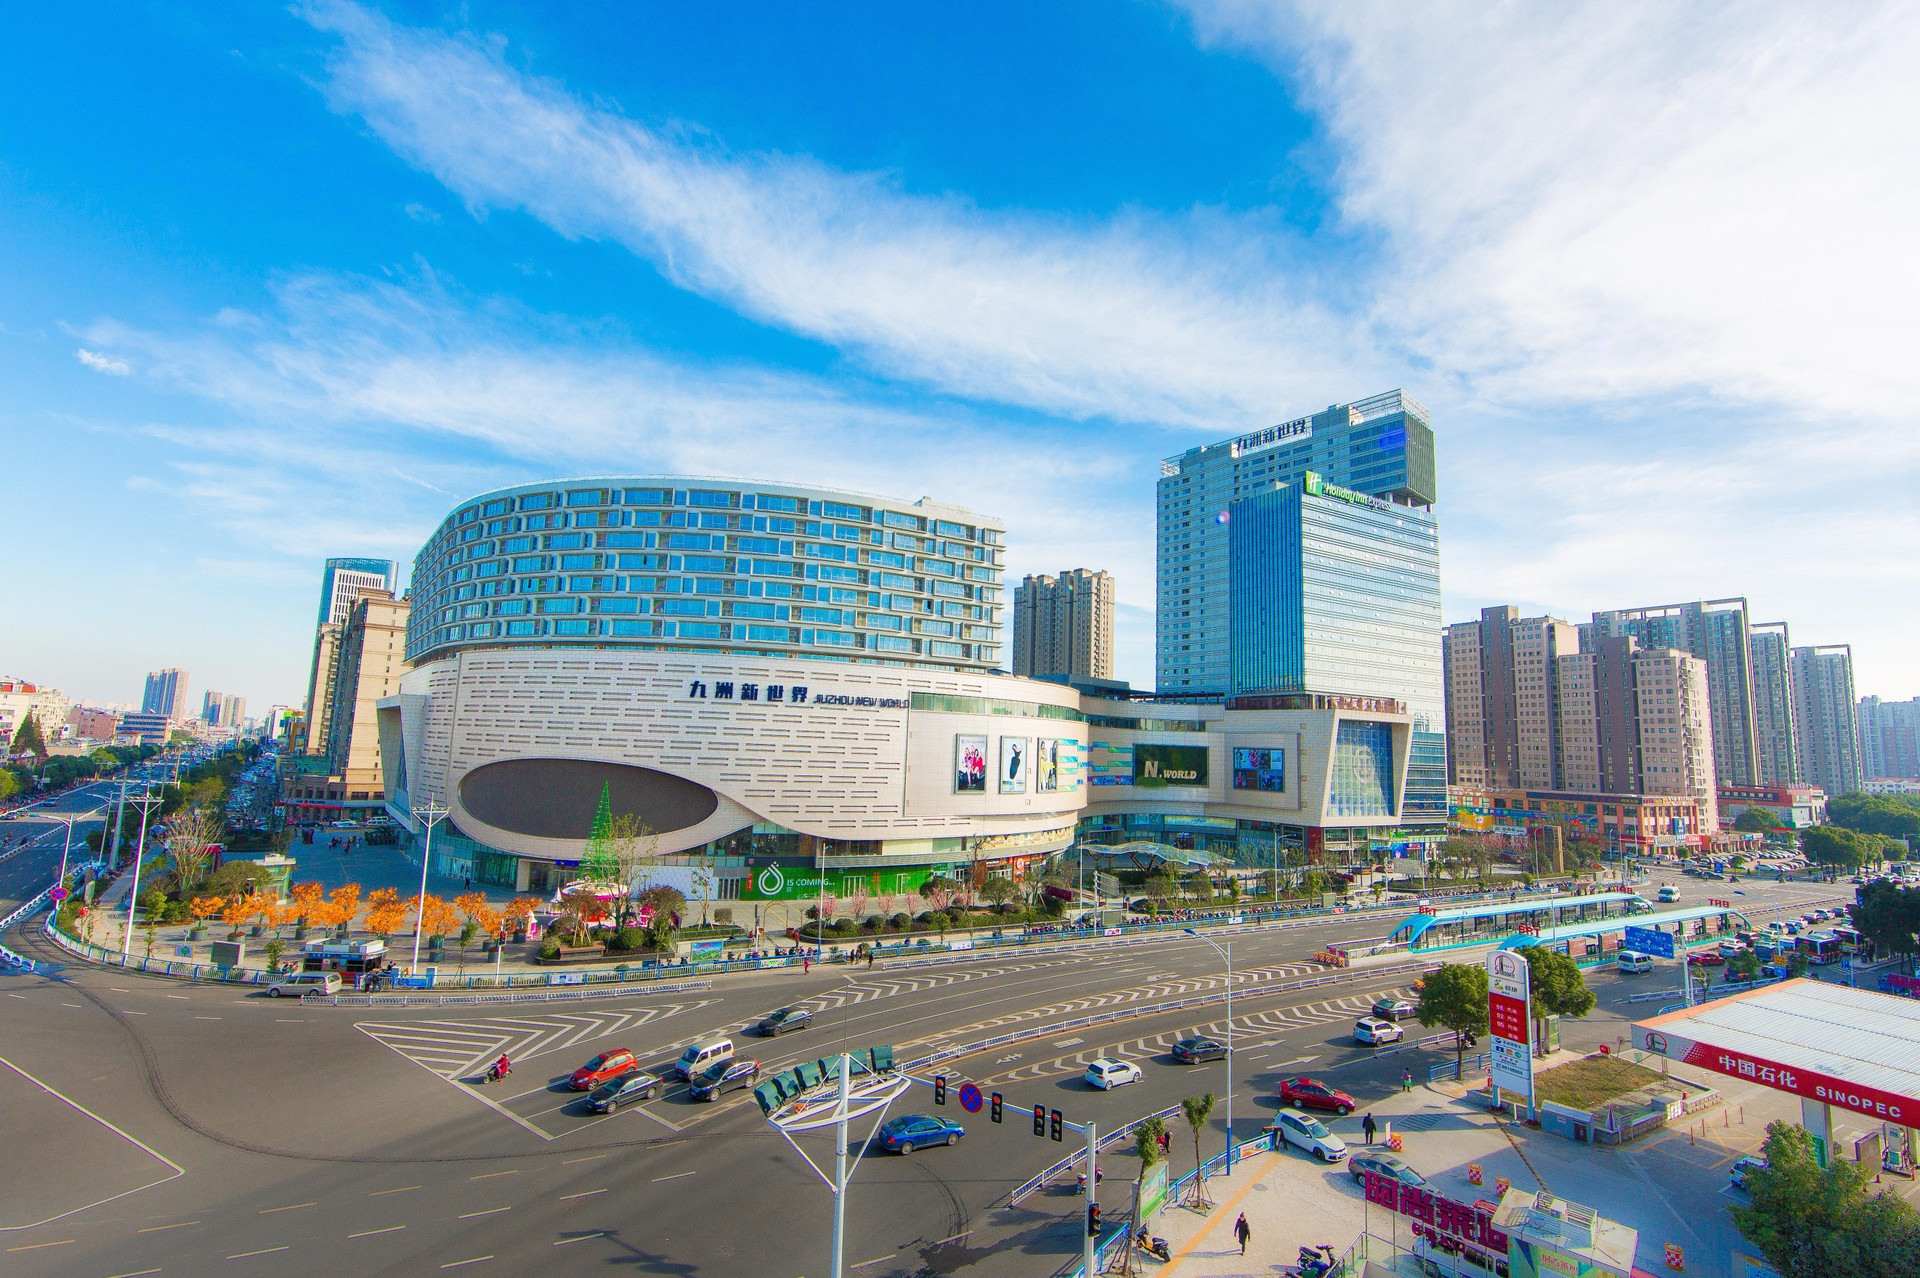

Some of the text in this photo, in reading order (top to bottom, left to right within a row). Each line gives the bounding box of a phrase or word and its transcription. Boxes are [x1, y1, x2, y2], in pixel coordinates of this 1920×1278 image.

[1236, 419, 1306, 451] 九洲新世界
[1325, 483, 1392, 510] Holiday Inn Express
[689, 681, 808, 702] 九洲新世界
[813, 694, 909, 709] JIUZHOU NEW WORLD
[787, 879, 794, 887] IS
[1419, 906, 1438, 917] BRT
[1518, 924, 1541, 938] BRT
[1719, 1055, 1798, 1089] 中国石化
[1815, 1086, 1903, 1119] SINOPEC
